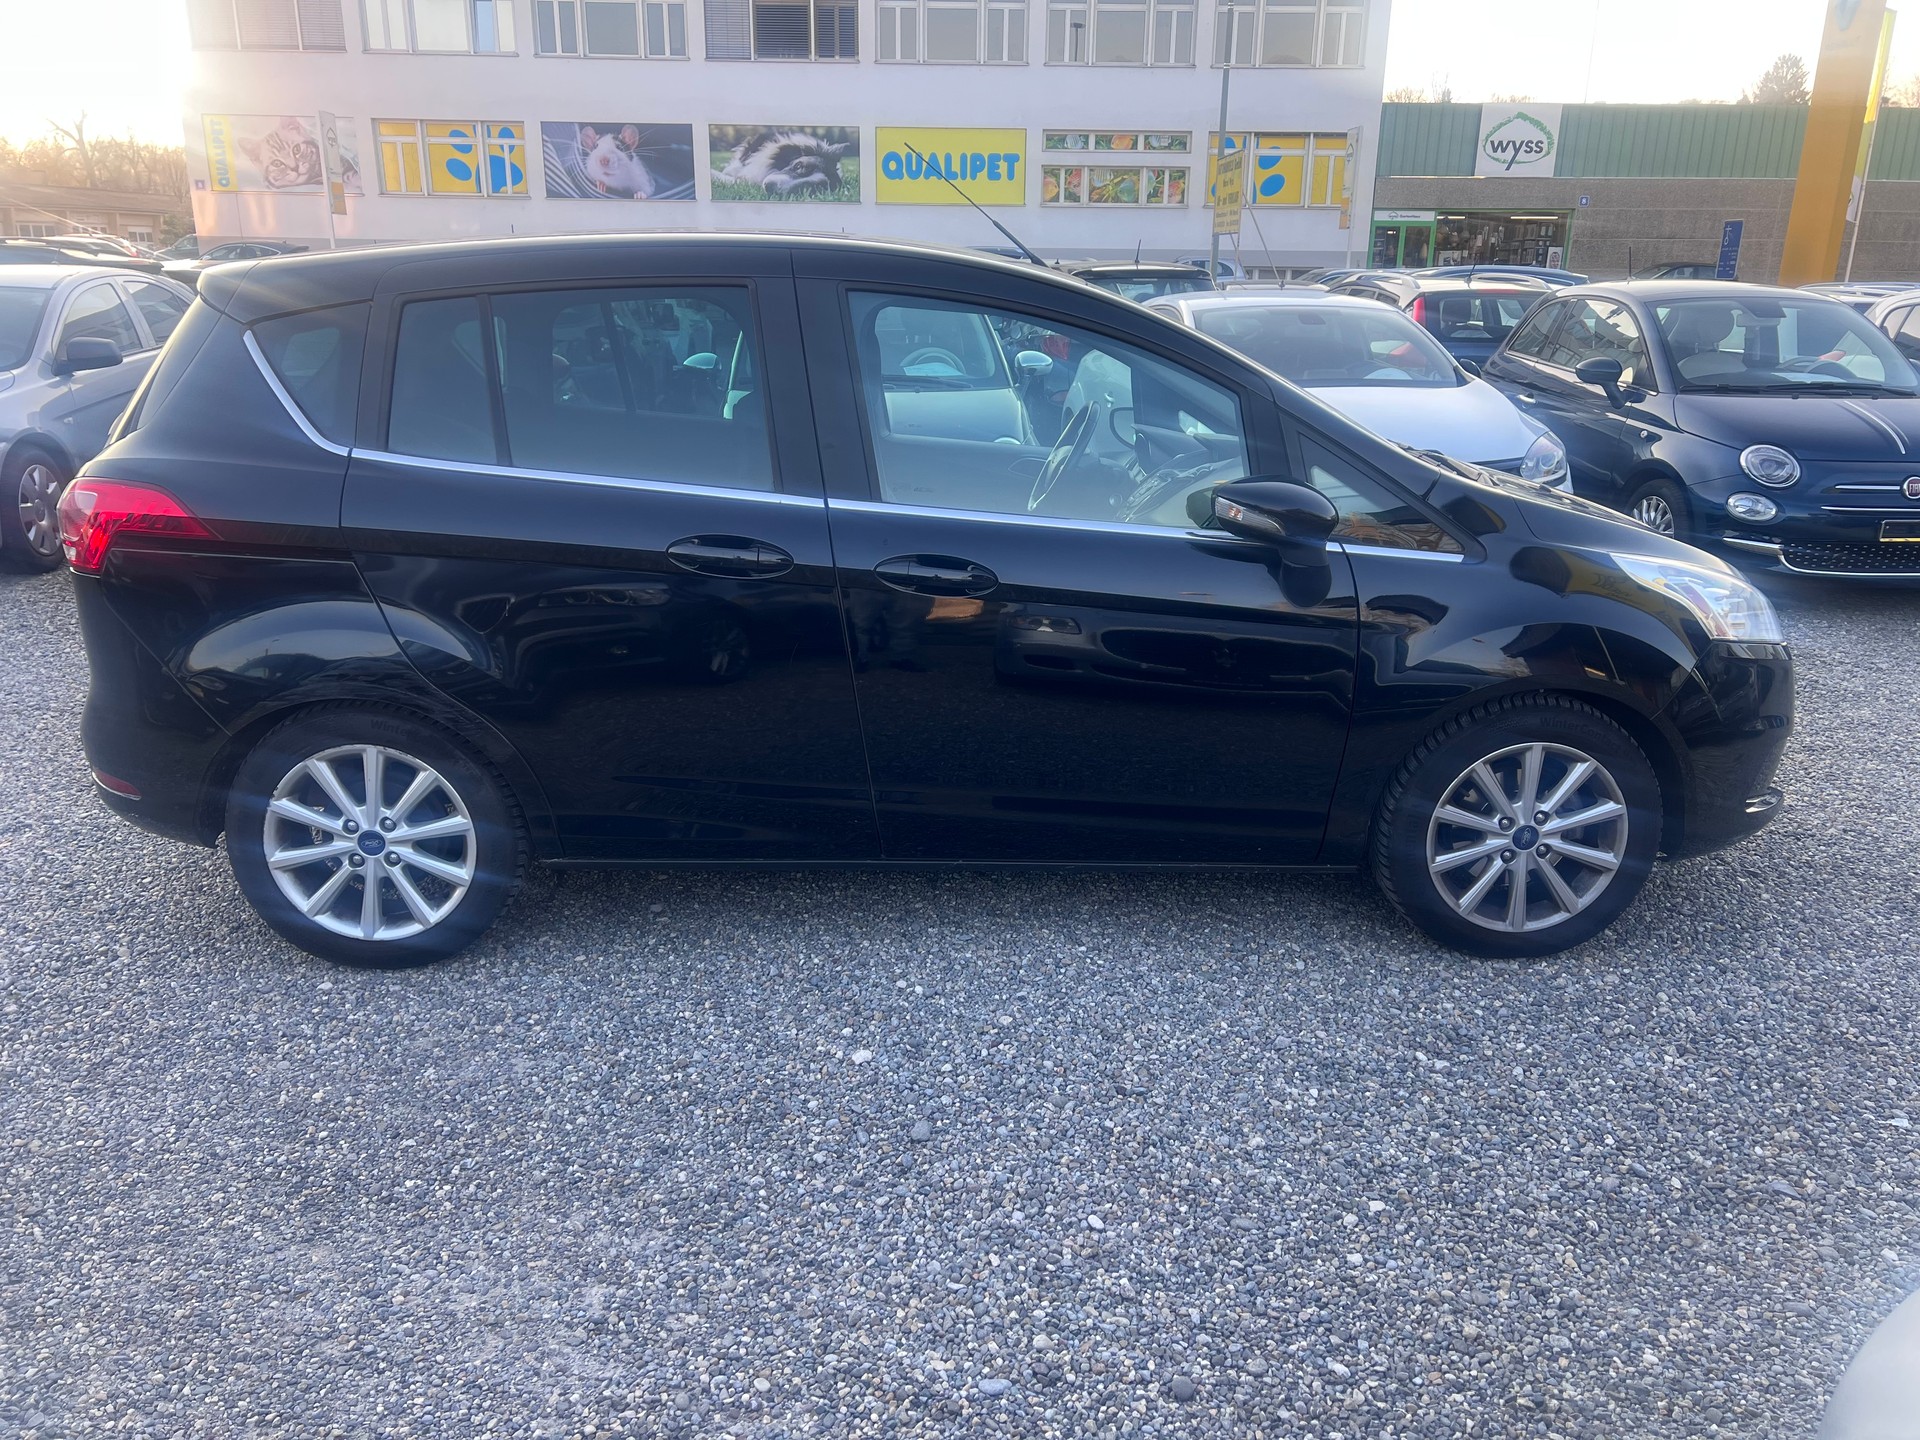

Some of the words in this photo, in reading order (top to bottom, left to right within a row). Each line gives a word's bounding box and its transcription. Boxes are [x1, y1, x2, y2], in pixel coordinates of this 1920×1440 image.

[209, 118, 231, 188] QUALIPET
[881, 151, 1021, 181] QUALIPET
[1490, 139, 1545, 171] wyss
